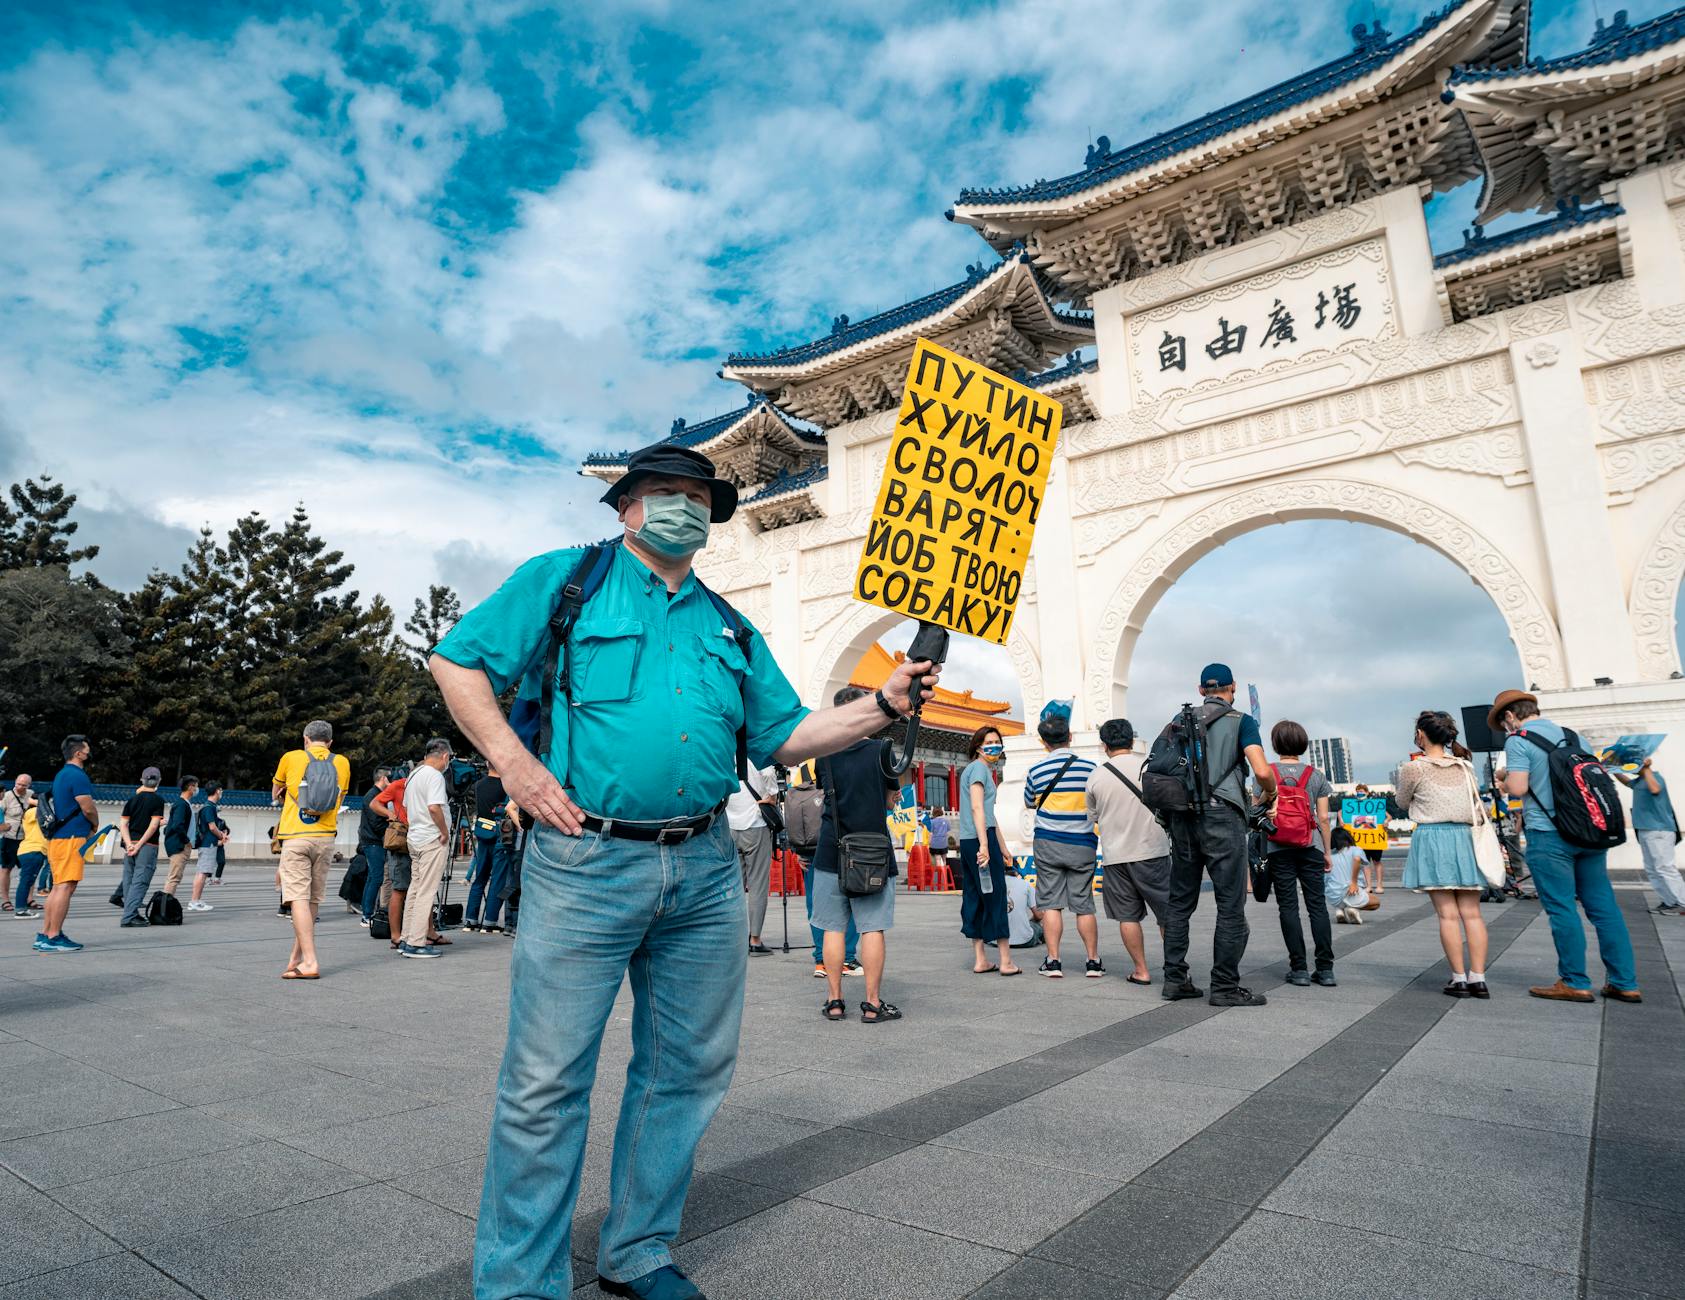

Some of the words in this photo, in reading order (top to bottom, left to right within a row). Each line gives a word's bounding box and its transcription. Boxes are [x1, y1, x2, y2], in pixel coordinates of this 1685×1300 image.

[900, 391, 1040, 477] ХУЙЛО
[915, 349, 1054, 442] ПУТИН
[894, 436, 1040, 525] СВОЛОЧ
[859, 564, 1013, 643] СОБАКУ!
[865, 517, 936, 574] ЙОБ
[951, 545, 1021, 606] ТВОЮ
[1345, 800, 1386, 815] STOP
[1353, 831, 1386, 845] UTIN
